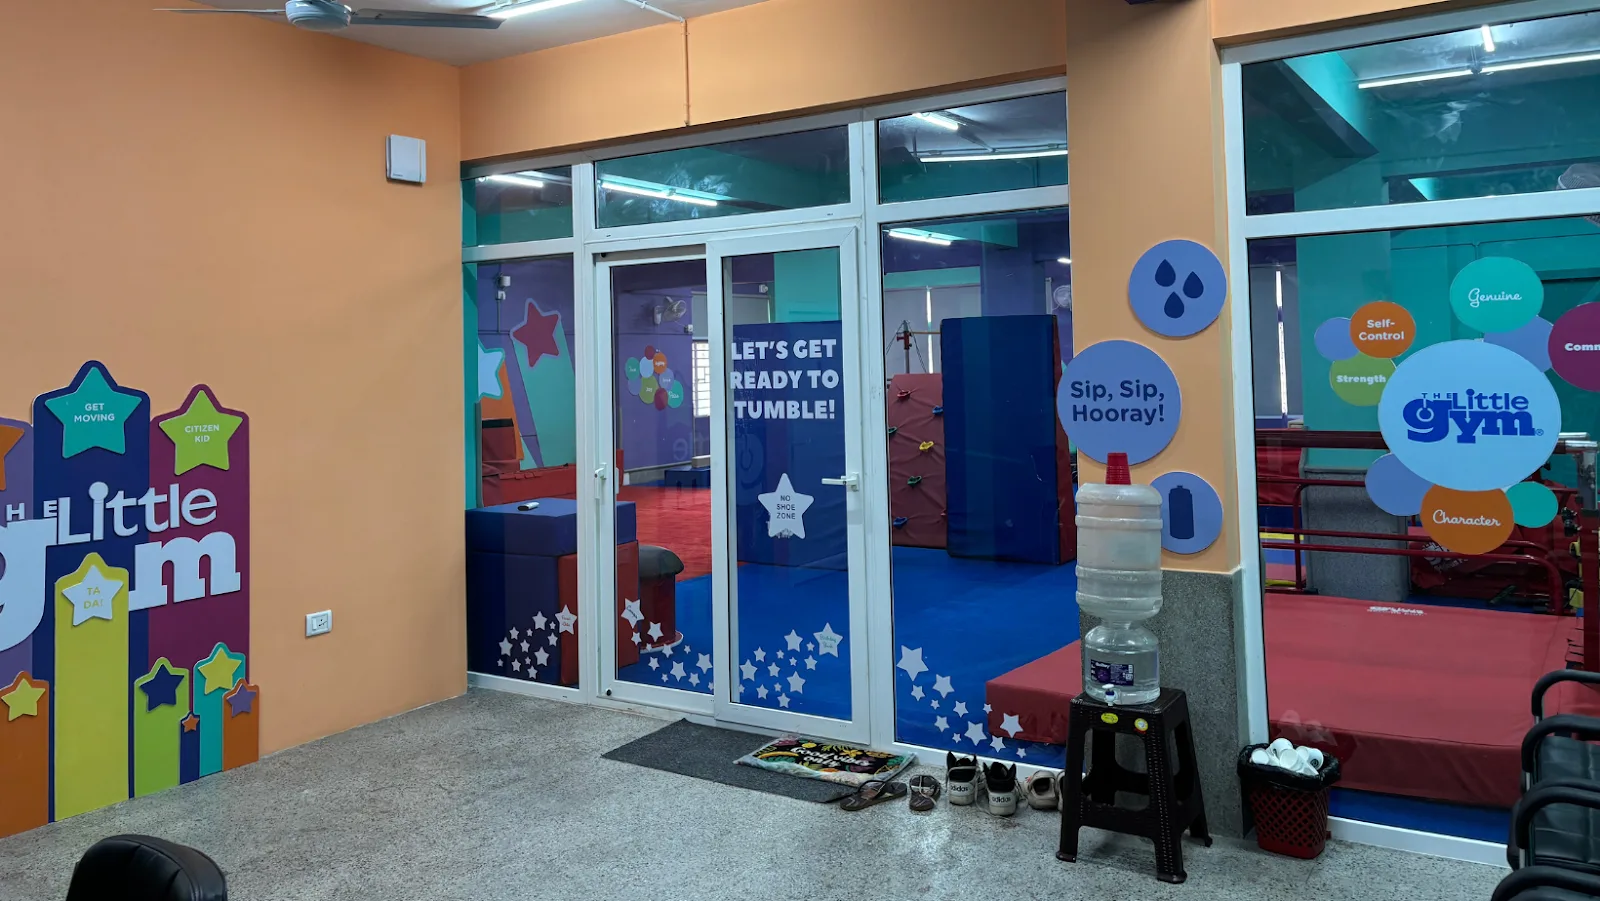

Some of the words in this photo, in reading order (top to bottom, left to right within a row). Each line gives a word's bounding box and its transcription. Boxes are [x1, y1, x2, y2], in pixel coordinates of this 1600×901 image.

[1468, 288, 1522, 307] Genuine
[1366, 319, 1396, 329] Self-
[1358, 331, 1405, 341] Control
[793, 339, 836, 359] GET
[729, 370, 802, 389] READY
[807, 369, 839, 388] TO
[1336, 374, 1386, 385] Strength
[1070, 380, 1113, 402] Sip,
[1119, 379, 1165, 402] Sip,
[1452, 388, 1529, 410] Little
[84, 402, 104, 412] GET
[734, 399, 835, 419] TUMBLE!
[73, 412, 115, 423] MOVING
[1072, 404, 1165, 426] Hooray!
[1402, 398, 1536, 444] gym
[184, 423, 220, 433] CITIZEN
[194, 434, 210, 443] KID
[776, 503, 796, 511] SHOE
[6, 500, 57, 520] HE
[57, 481, 218, 545] Little
[776, 512, 796, 520] ZONE
[1432, 508, 1501, 527] Character
[87, 587, 101, 596] TA
[83, 599, 103, 609] DA!
